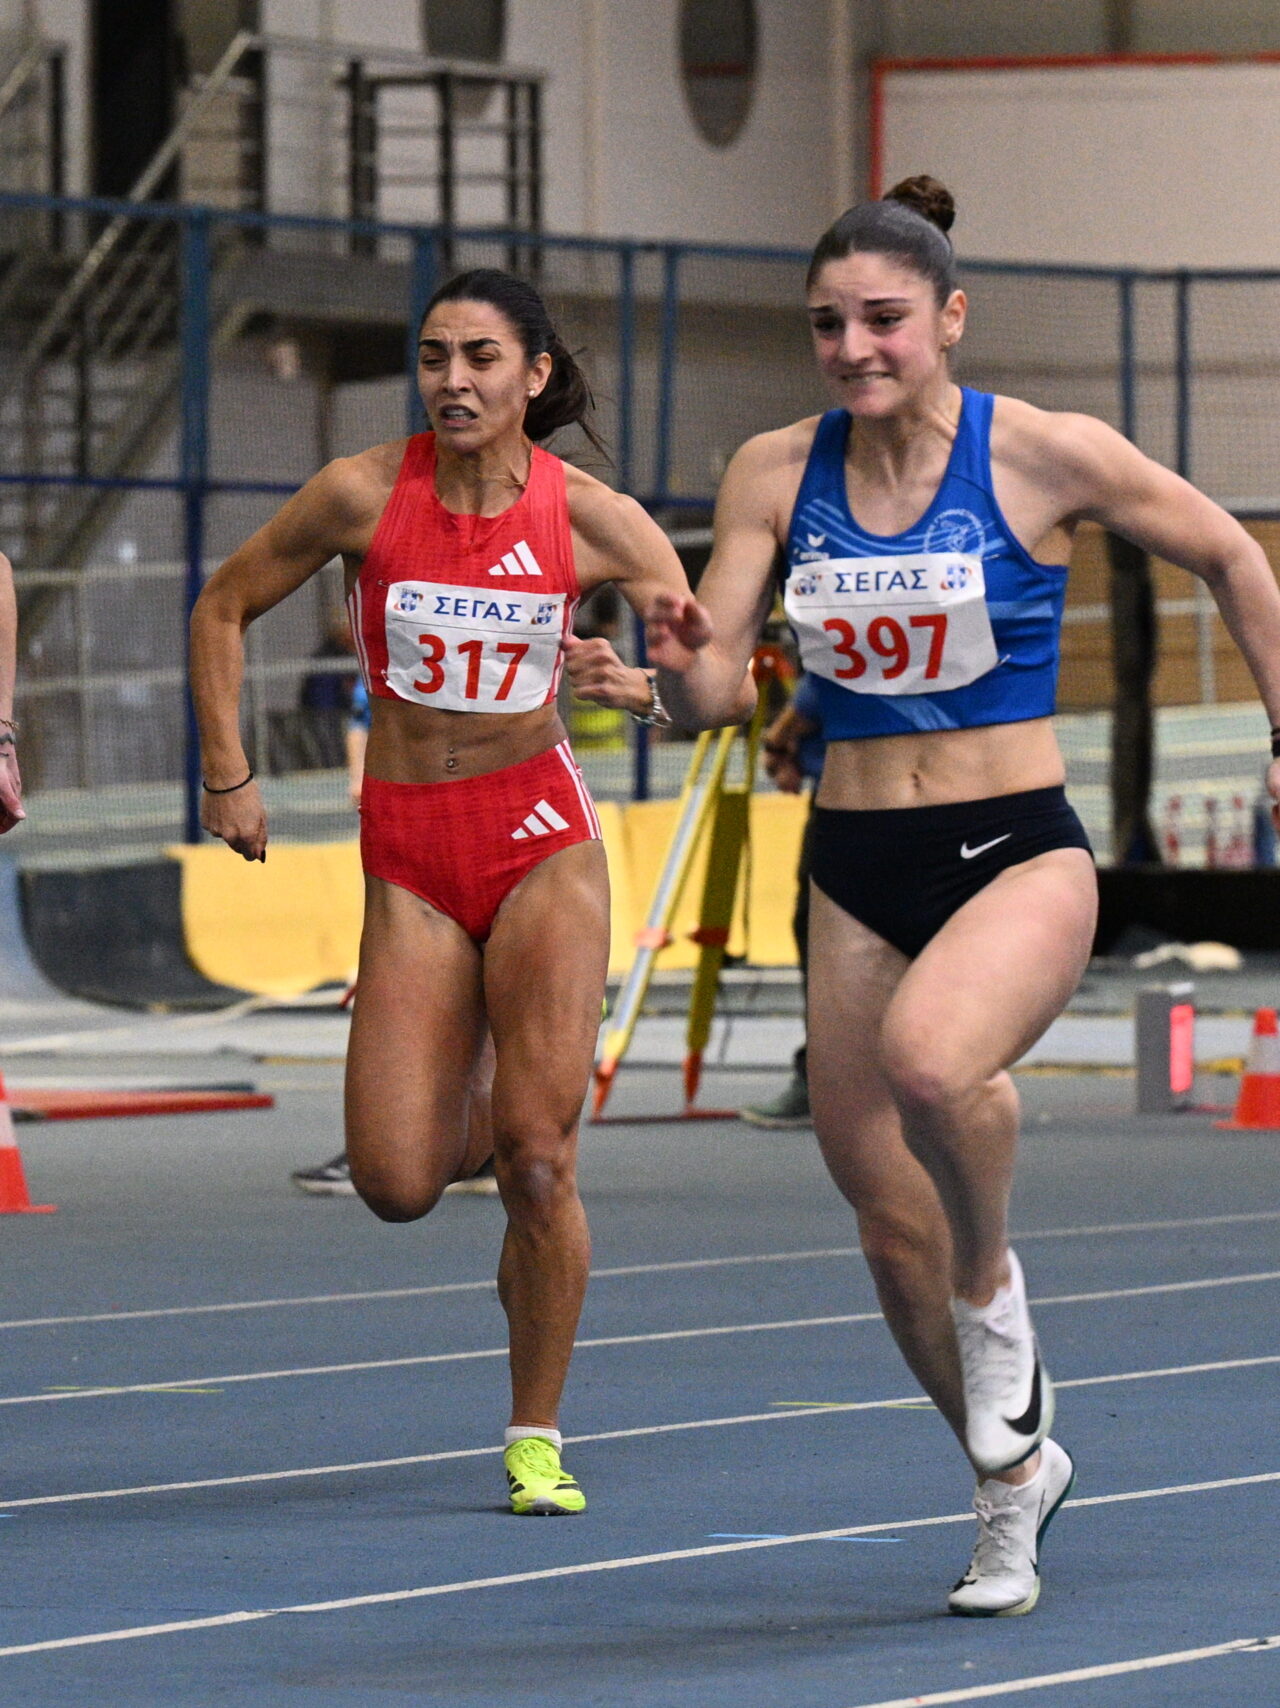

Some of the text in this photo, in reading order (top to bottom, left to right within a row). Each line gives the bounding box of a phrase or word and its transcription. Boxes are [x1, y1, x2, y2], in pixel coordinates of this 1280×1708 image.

[834, 568, 928, 593] ΣΕΓΑΣ
[433, 595, 522, 623] ΣΕΓΑΣ
[413, 634, 530, 701] 317
[823, 613, 947, 680] 397
